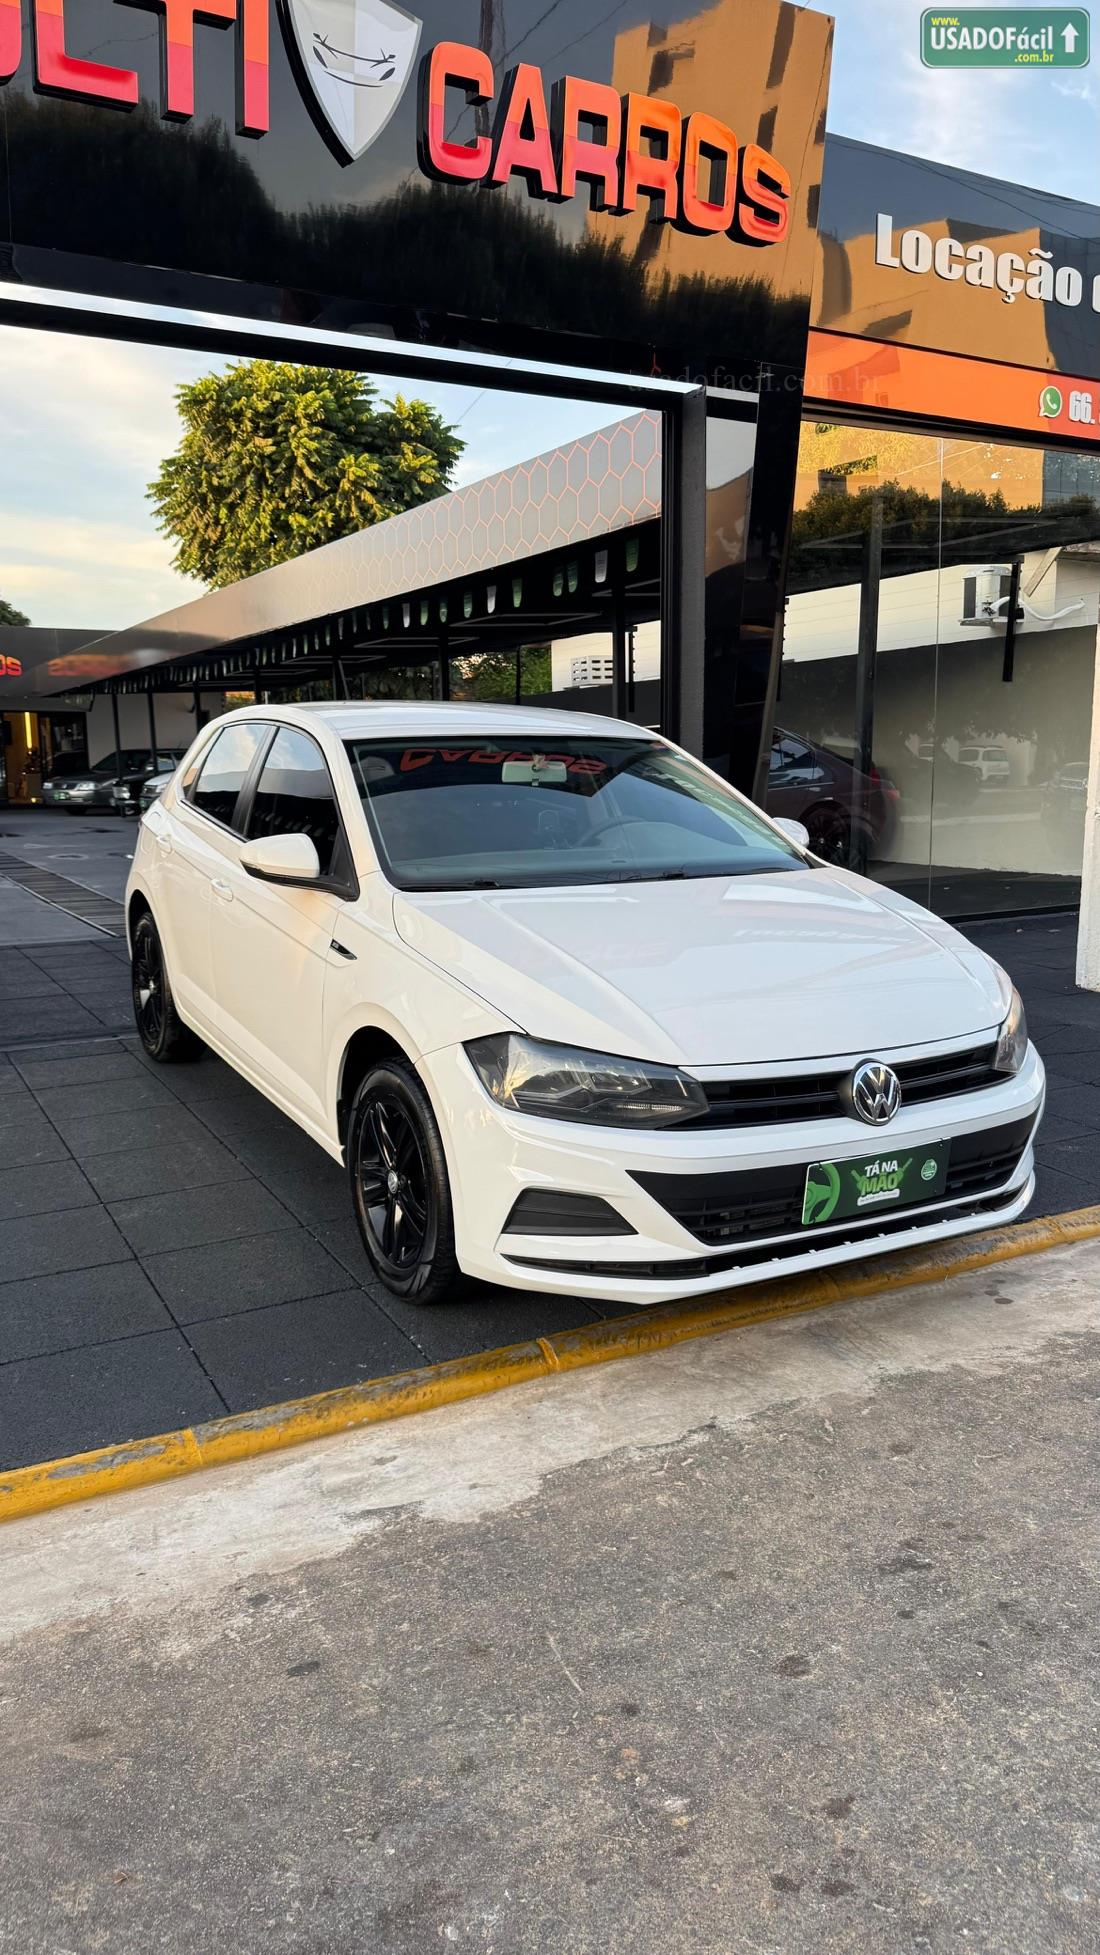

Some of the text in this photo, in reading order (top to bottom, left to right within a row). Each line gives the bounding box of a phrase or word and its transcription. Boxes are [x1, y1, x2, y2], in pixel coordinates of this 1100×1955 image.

[0, 0, 792, 247] LTI CARROS
[875, 213, 1083, 303] Locação
[861, 1174, 898, 1196] MÃO
[864, 1160, 898, 1178] TÁ NA
